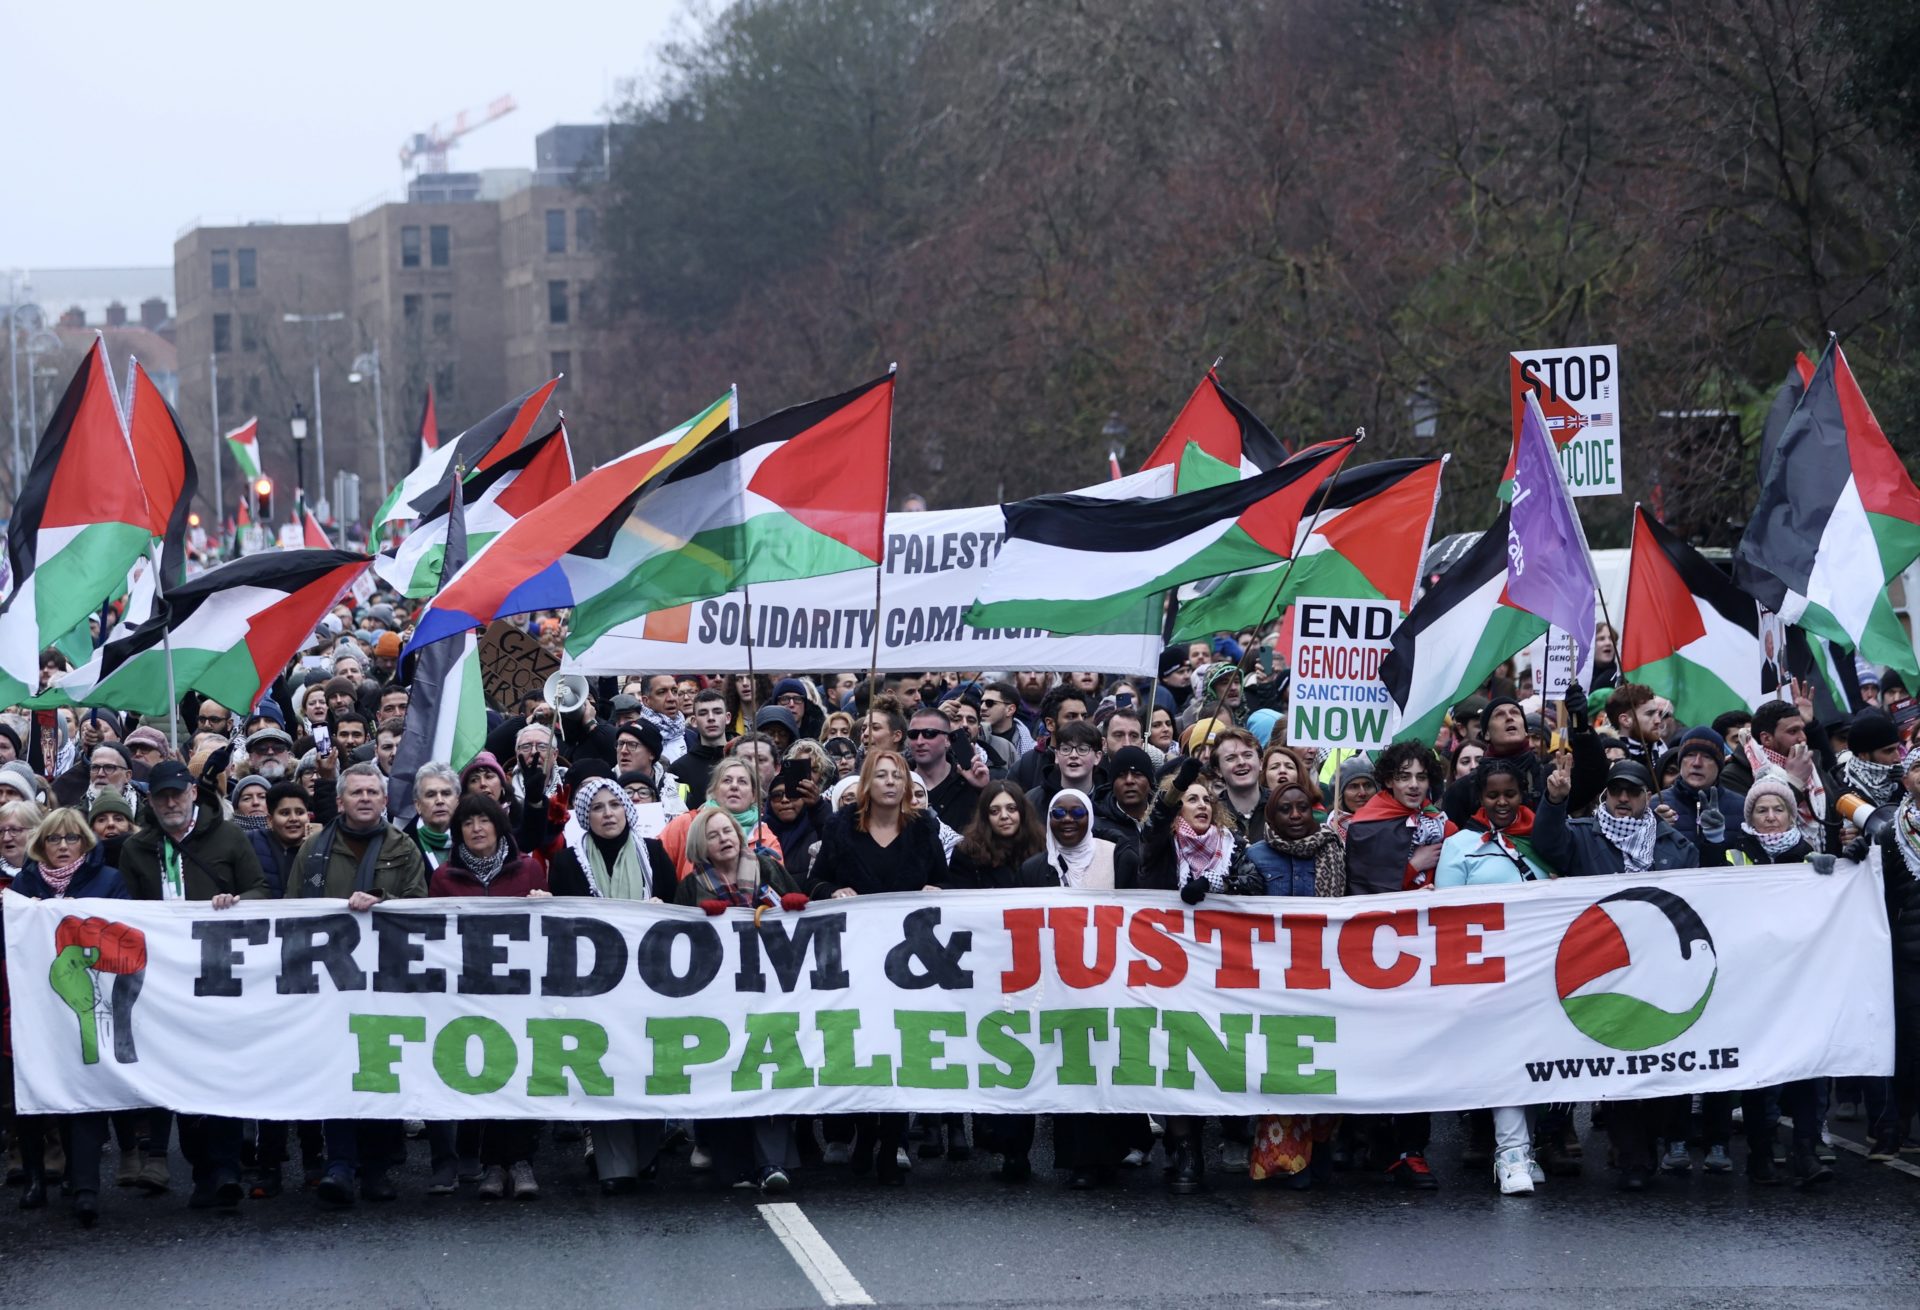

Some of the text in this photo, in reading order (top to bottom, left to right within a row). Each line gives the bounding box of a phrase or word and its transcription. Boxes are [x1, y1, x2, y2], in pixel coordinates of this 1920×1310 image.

[1520, 354, 1611, 403] STOP
[1560, 439, 1616, 486] OCIDE
[698, 600, 878, 649] SOLIDARITY
[1300, 604, 1393, 640] END
[500, 630, 561, 682] GAZ
[1296, 683, 1389, 703] SANCTIONS
[1294, 705, 1389, 743] NOW
[192, 902, 1505, 998] FREEDOM & JUSTICE
[349, 1007, 1337, 1096] FOR PALESTINE
[1525, 1047, 1739, 1082] WWW.IPSC.IE
